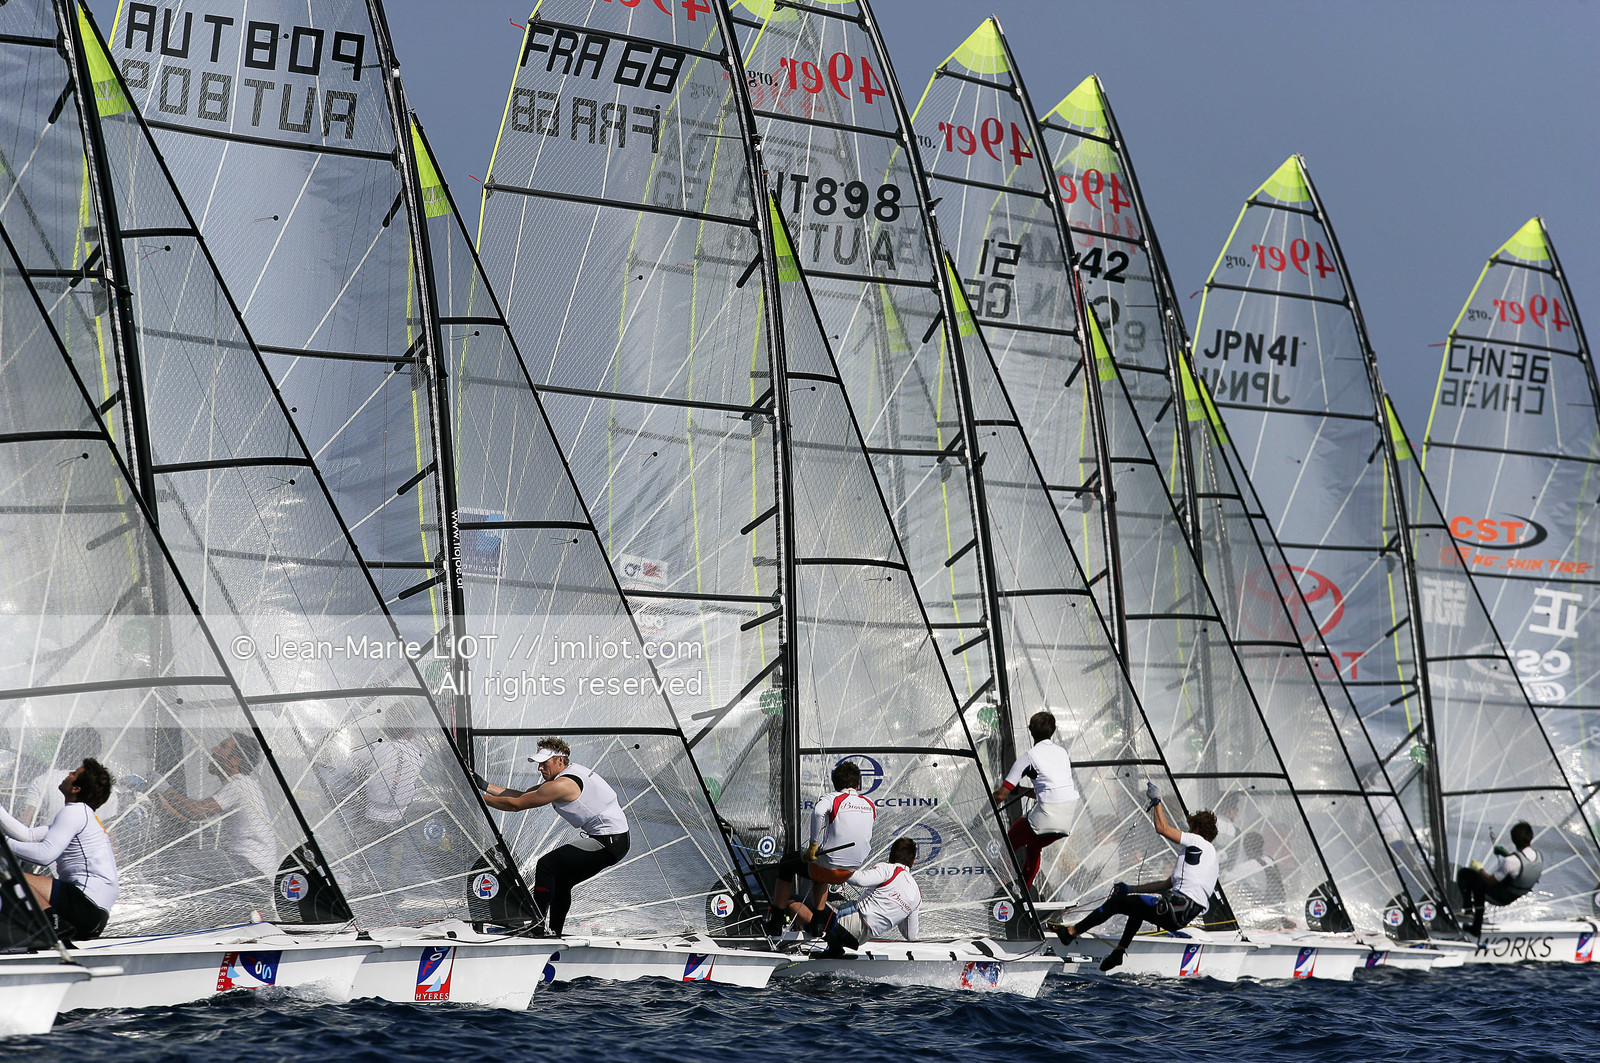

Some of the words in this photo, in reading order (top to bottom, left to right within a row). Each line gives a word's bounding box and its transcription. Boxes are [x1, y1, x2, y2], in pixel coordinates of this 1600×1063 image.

[1449, 515, 1524, 544] CST
[873, 797, 938, 808] CCHINI
[415, 992, 449, 1000] HYERES
